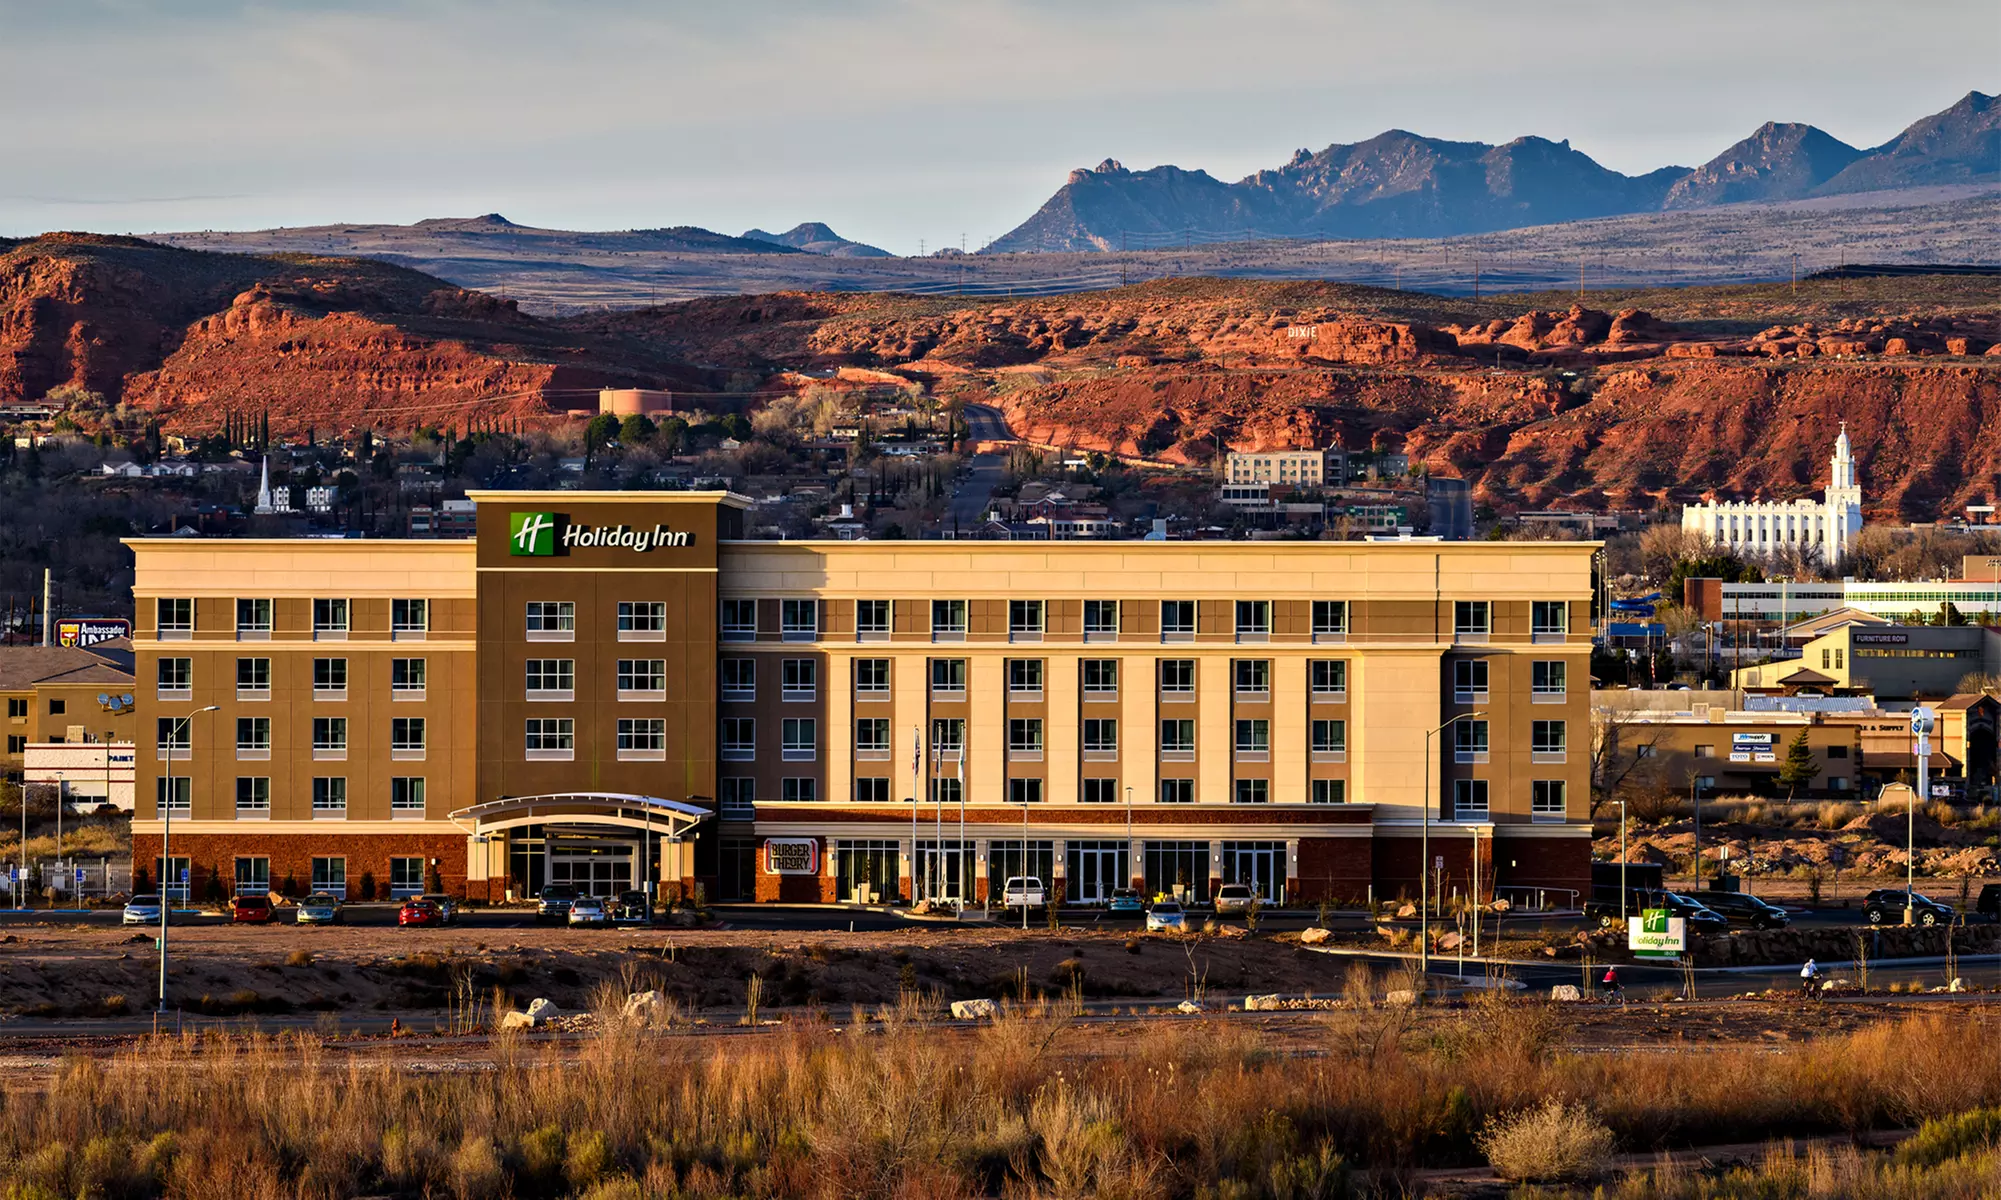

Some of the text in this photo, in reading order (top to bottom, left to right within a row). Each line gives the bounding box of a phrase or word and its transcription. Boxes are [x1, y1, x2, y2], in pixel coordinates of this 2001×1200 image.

[1288, 326, 1317, 338] DIXIE
[562, 524, 690, 552] Holiday Inn
[81, 622, 125, 634] Ambassador
[772, 844, 810, 856] BURGER
[771, 857, 810, 870] THEORY
[1632, 936, 1680, 947] Holiday Inn
